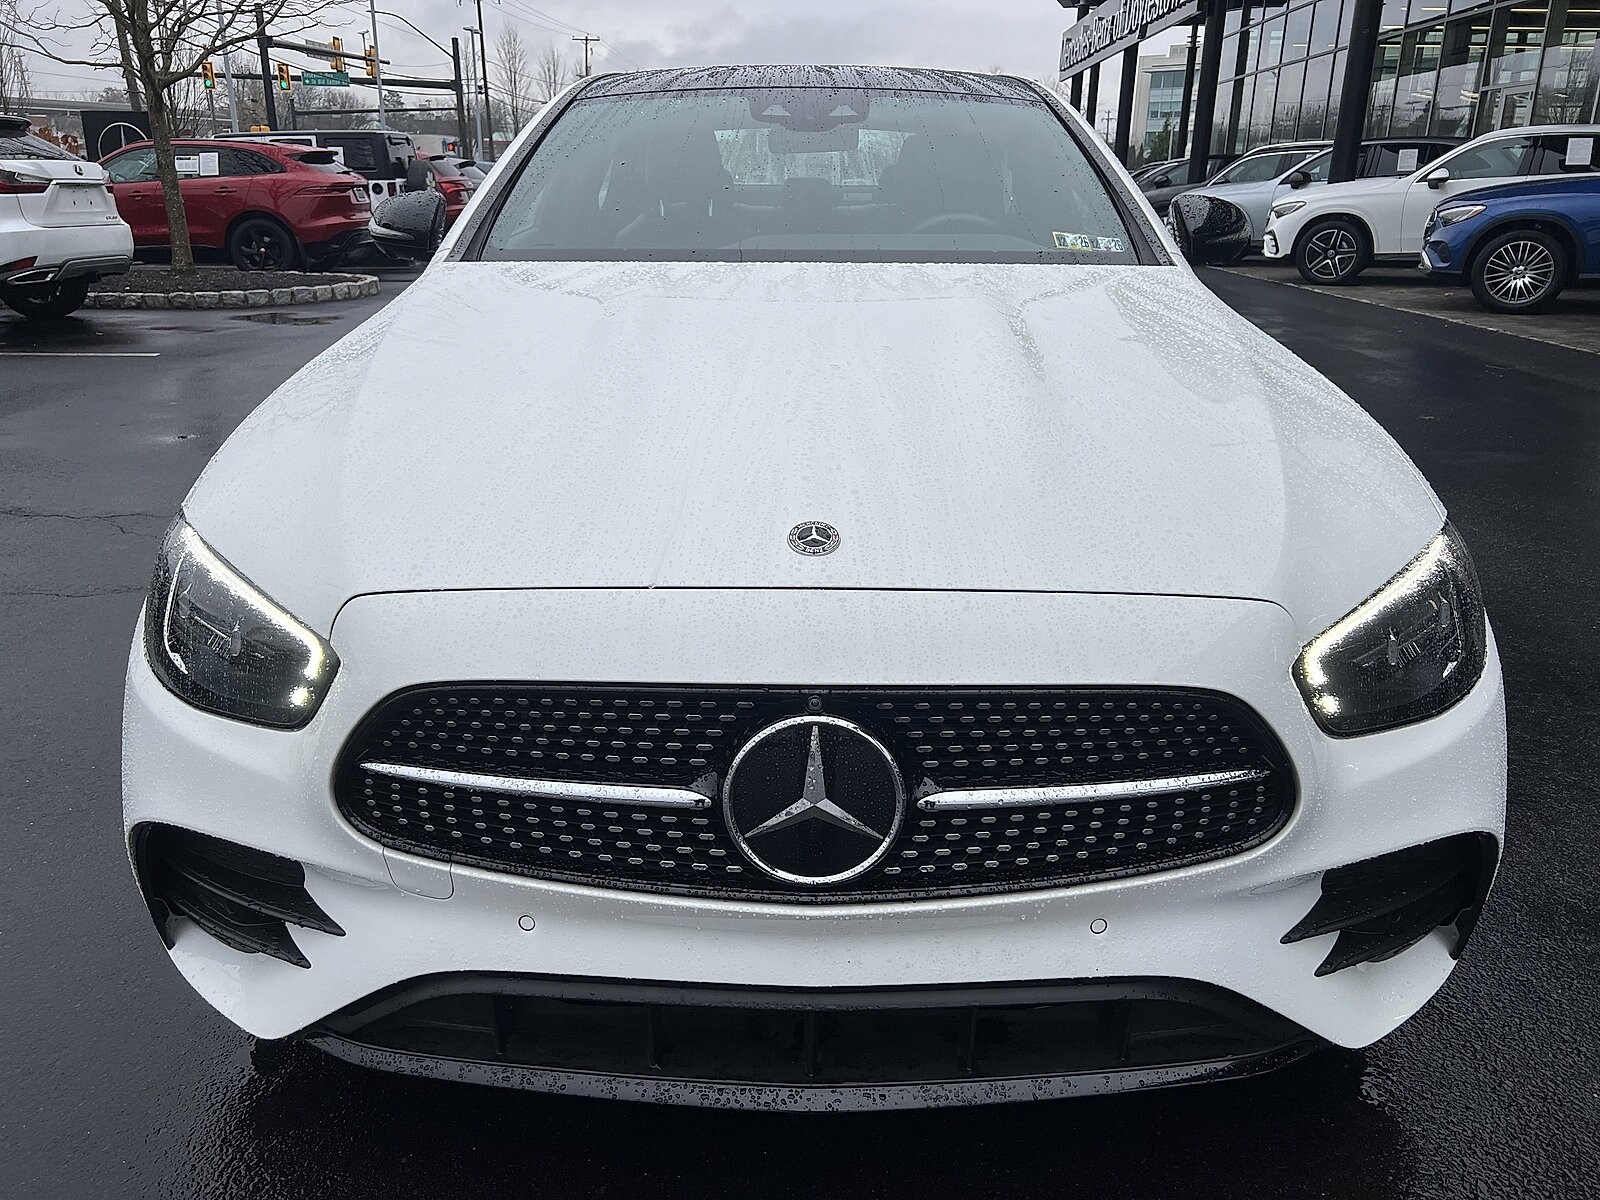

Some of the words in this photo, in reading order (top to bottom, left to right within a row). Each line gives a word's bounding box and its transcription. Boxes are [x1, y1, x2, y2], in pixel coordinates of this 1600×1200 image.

[1060, 15, 1112, 71] Mercedes-Benz
[1124, 0, 1185, 39] Doyles
[1079, 235, 1090, 248] 26
[1111, 239, 1124, 251] 26
